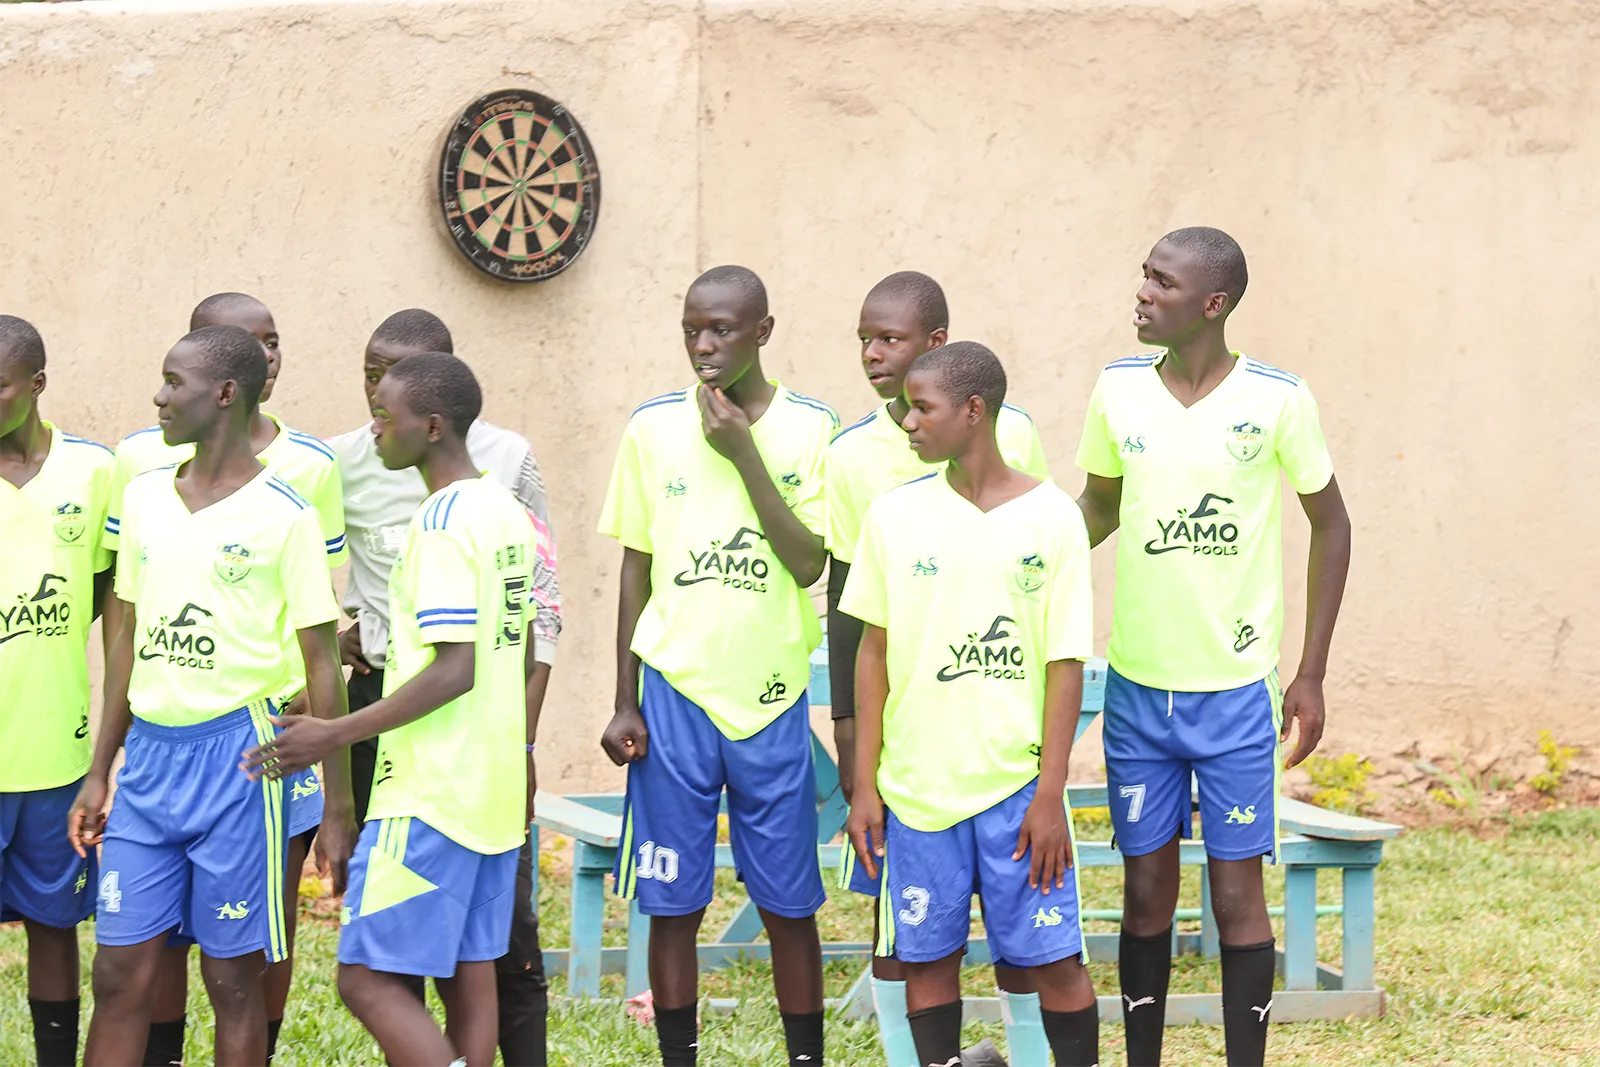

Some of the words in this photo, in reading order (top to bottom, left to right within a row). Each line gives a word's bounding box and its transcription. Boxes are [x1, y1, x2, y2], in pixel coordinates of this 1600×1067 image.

[1157, 519, 1239, 544] YAMO
[1193, 545, 1239, 556] POOLS
[689, 550, 769, 578] YAMO
[723, 576, 768, 594] POOLS
[0, 602, 71, 633] YAMO
[36, 625, 70, 638] POOLS
[146, 626, 216, 656] YAMO
[168, 654, 215, 670] POOLS
[949, 644, 1024, 669] YAMO
[983, 668, 1026, 680] POOLS
[290, 776, 320, 802] AS
[1119, 783, 1147, 823] 7
[1224, 805, 1257, 825] AS
[635, 840, 680, 884] 10
[99, 870, 122, 914] 4
[216, 900, 250, 921] AS
[899, 885, 932, 927] 3
[1031, 905, 1063, 928] AS
